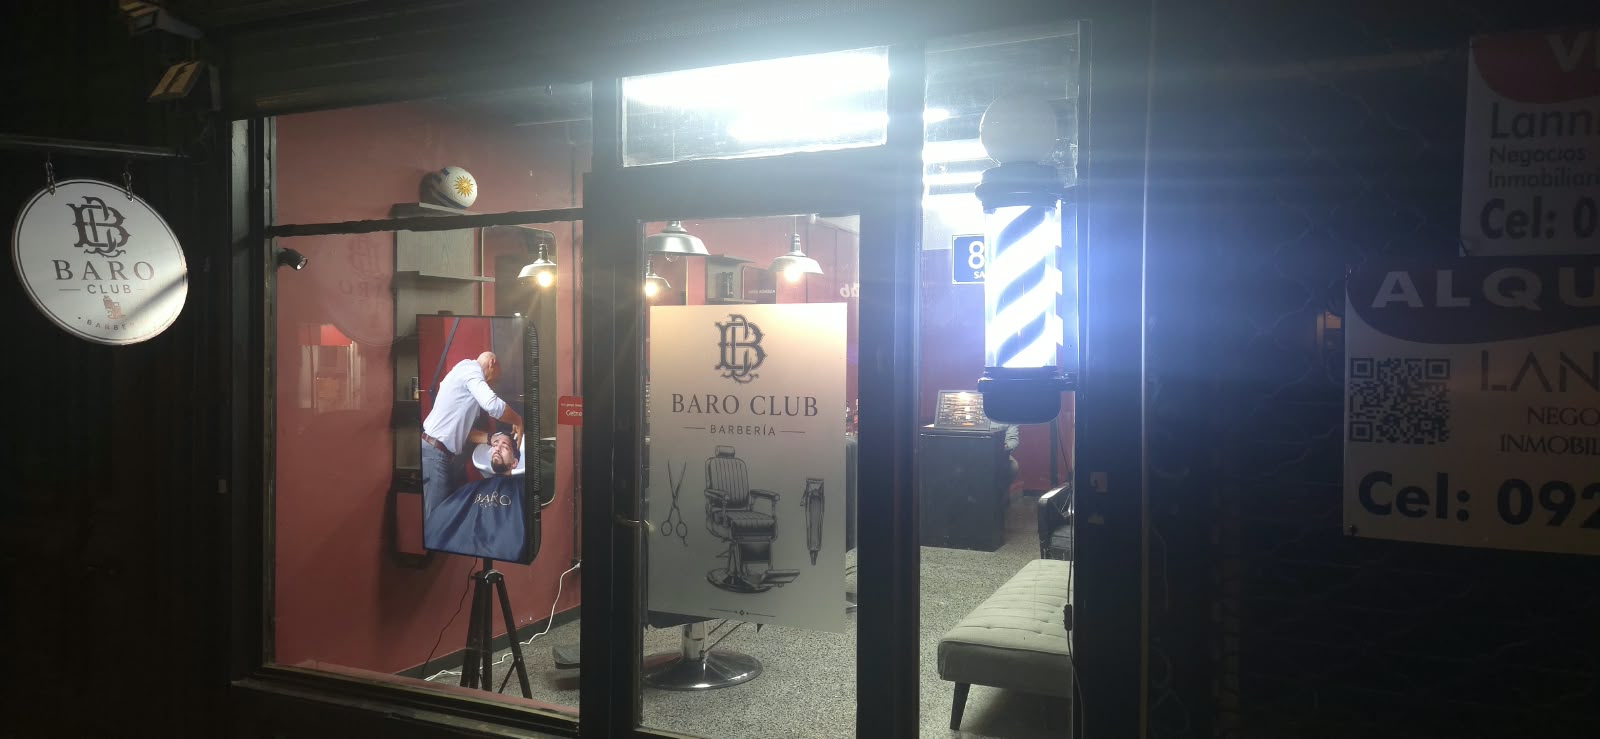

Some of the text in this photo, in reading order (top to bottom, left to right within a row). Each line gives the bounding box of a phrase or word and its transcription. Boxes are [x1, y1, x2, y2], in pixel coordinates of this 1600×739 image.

[1489, 144, 1586, 167] Negocios
[1480, 195, 1599, 240] Cel: 0
[51, 259, 155, 281] BARO
[87, 284, 131, 294] CLUB
[1371, 267, 1600, 311] ALQU
[1480, 350, 1600, 392] LAN
[671, 393, 818, 417] BARO CLUB
[1527, 405, 1600, 426] NEGO
[709, 423, 776, 436] BARBERÍA
[1500, 433, 1600, 456] INMOBIL
[473, 490, 511, 506] BARO
[1358, 470, 1600, 529] Cel: 092
